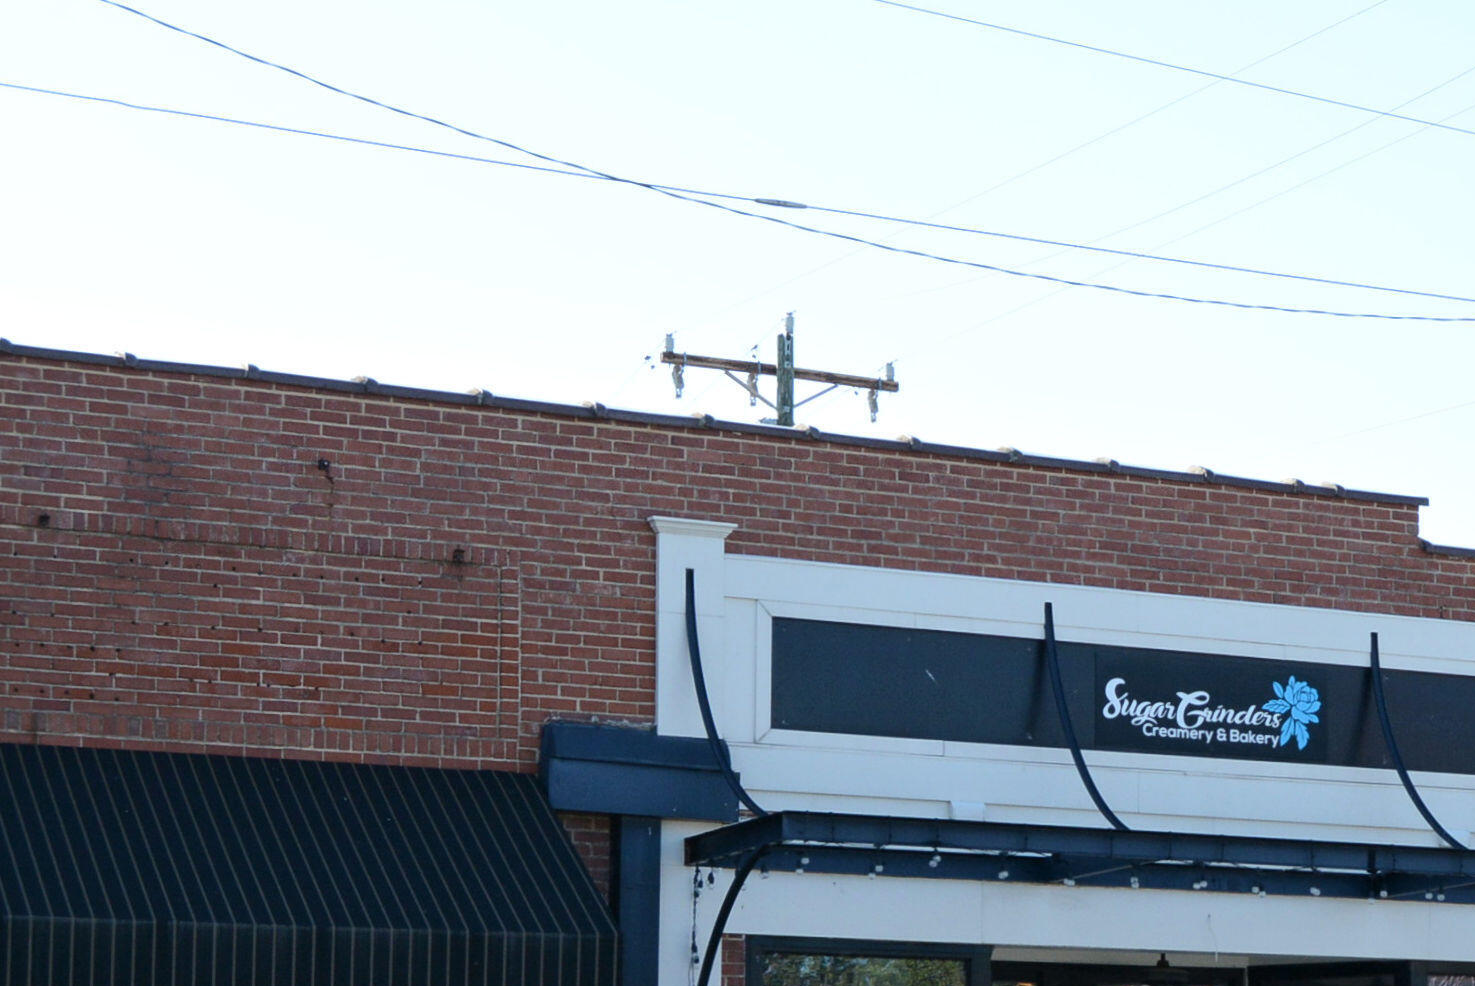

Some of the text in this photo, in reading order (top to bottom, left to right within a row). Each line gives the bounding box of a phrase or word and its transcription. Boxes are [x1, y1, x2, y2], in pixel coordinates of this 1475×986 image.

[1142, 723, 1280, 749] Creamery & Bakery
